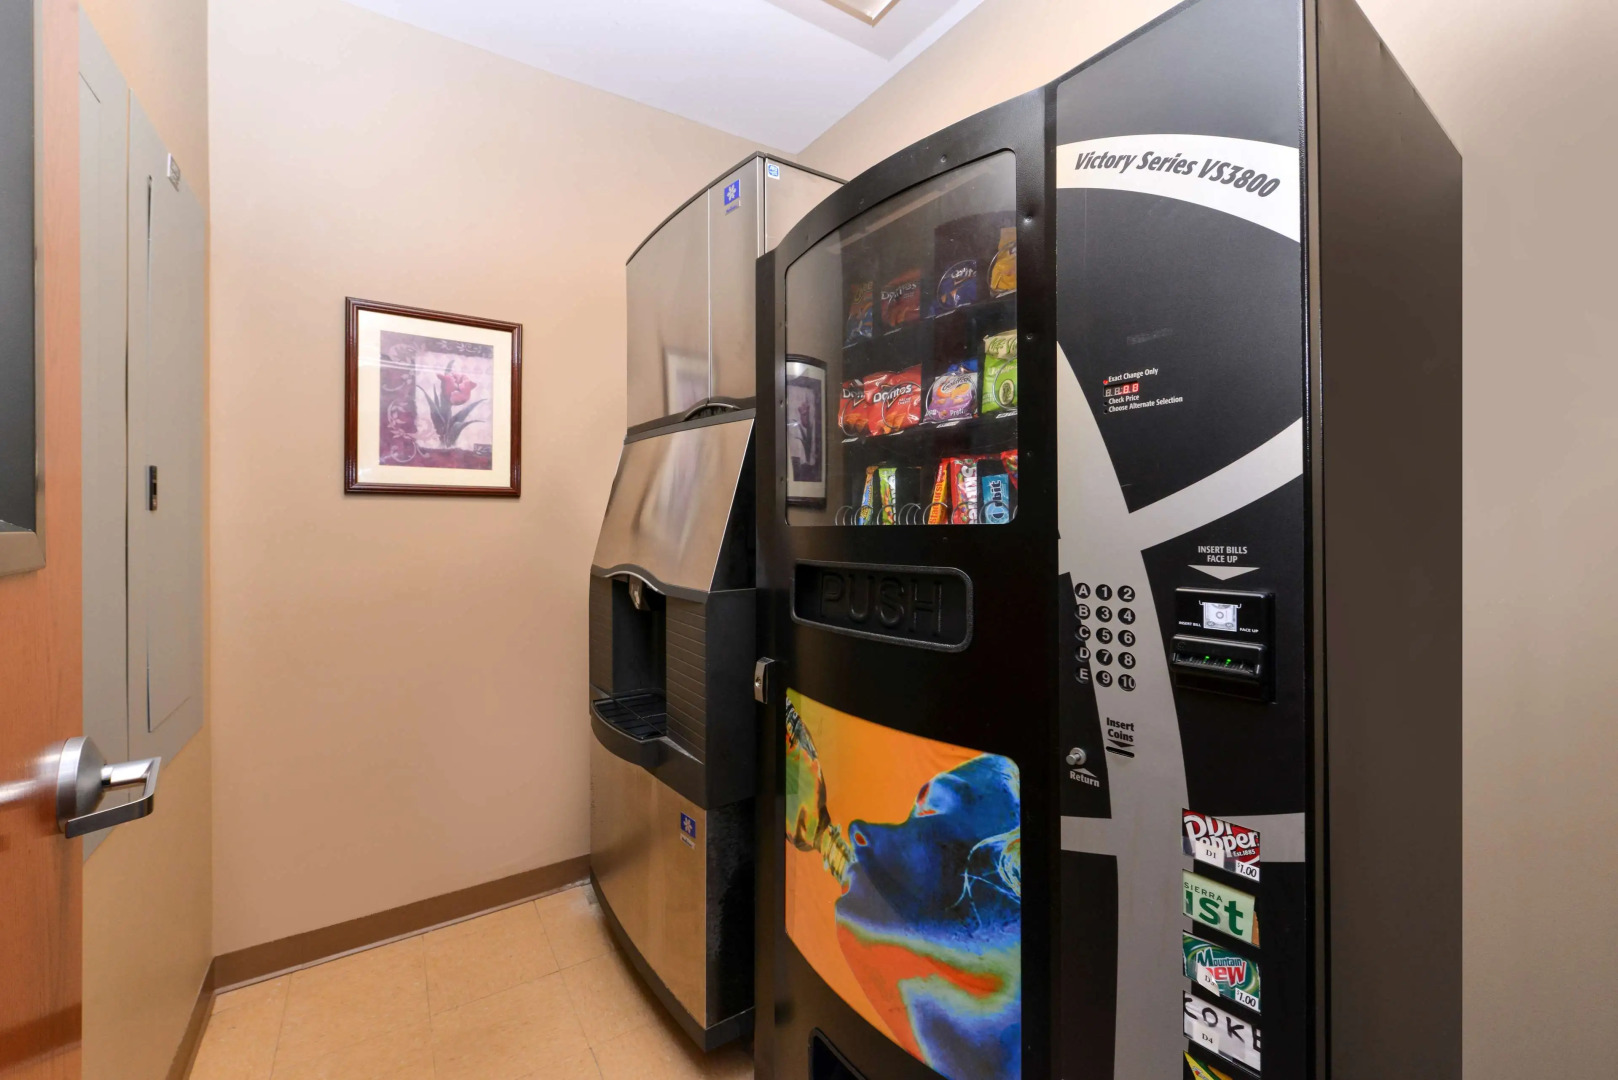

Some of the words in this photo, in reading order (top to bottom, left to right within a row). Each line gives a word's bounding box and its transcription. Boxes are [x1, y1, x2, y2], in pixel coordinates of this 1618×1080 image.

[1074, 151, 1137, 174] Victory
[1136, 151, 1198, 176] Series
[1197, 158, 1281, 198] VS3800
[1123, 371, 1144, 380] Change
[1144, 367, 1159, 376] Only
[873, 384, 913, 403] Doritos
[1108, 396, 1125, 405] Check
[1125, 394, 1140, 402] Price
[1108, 404, 1128, 413] Choose
[1129, 400, 1156, 410] Alternate
[1156, 395, 1184, 406] Selection
[1197, 545, 1225, 554] INSERT
[1226, 545, 1248, 555] BILLS
[1206, 554, 1225, 563] FACE
[1226, 555, 1238, 564] UP
[820, 571, 943, 637] PUSH
[1121, 676, 1136, 689] 10
[1106, 717, 1135, 732] Insert
[1107, 728, 1134, 742] Coins
[1069, 770, 1100, 788] Return
[1184, 881, 1223, 903] SIERRA
[1183, 996, 1261, 1053] COKE
[1202, 1032, 1213, 1044] D4
